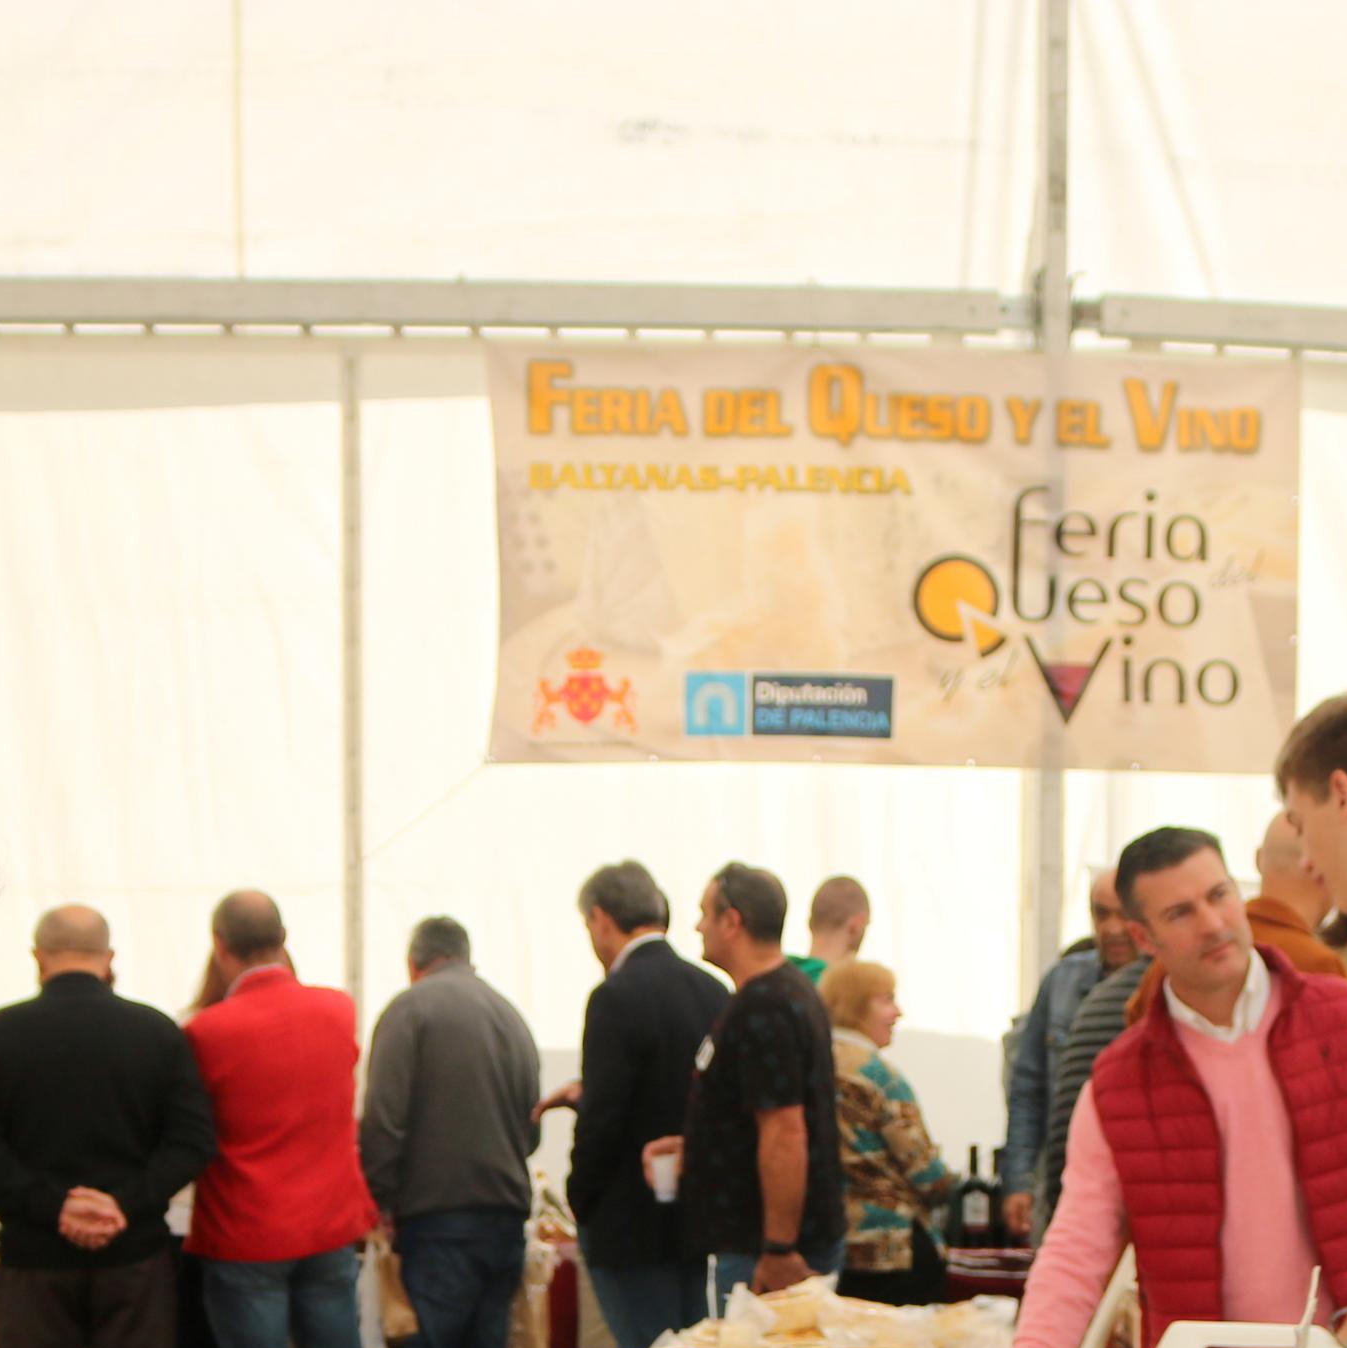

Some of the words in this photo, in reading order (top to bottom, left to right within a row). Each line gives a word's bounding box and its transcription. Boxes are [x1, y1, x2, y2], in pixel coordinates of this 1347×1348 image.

[1005, 395, 1043, 446] Y
[1056, 398, 1111, 449] EL
[755, 681, 868, 706] Diputación
[755, 707, 786, 729] DE
[789, 708, 890, 731] PALENCIA
